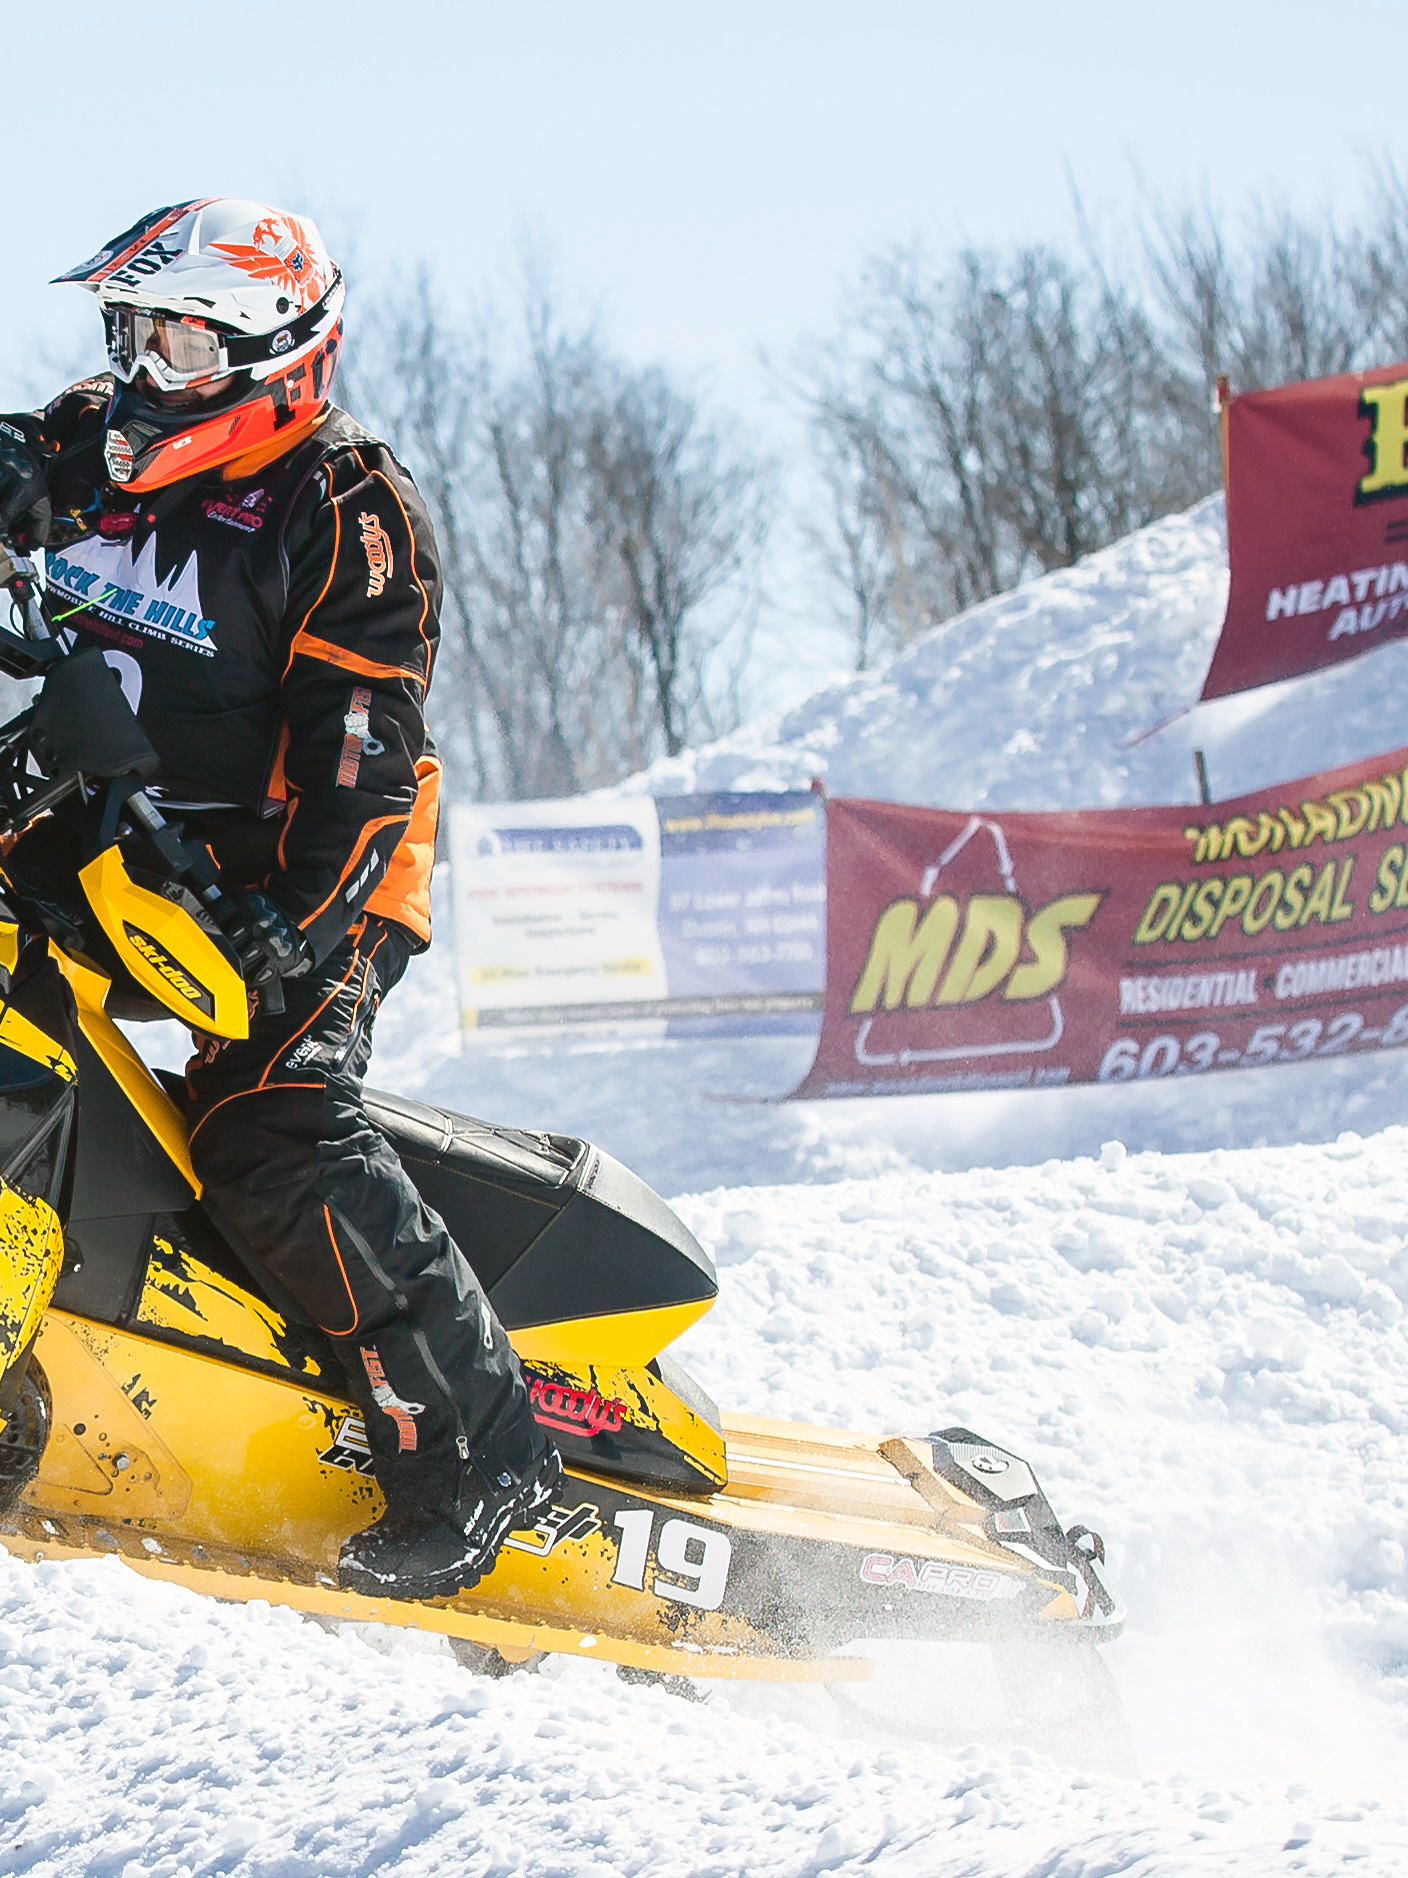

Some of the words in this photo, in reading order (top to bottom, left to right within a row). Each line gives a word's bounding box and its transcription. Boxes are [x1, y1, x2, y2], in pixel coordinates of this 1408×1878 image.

[108, 241, 186, 288] FOX
[98, 582, 145, 616] THE
[143, 600, 217, 640] HILLS
[128, 620, 166, 643] CLIMB
[171, 636, 216, 658] SERIES
[1133, 854, 1356, 946] DISPOSAL
[129, 934, 202, 1000] ski-doo
[848, 893, 1108, 1016] MDS
[1119, 967, 1258, 1015] RESIDENTIAL
[611, 1509, 731, 1610] 19
[862, 1555, 916, 1586] CA
